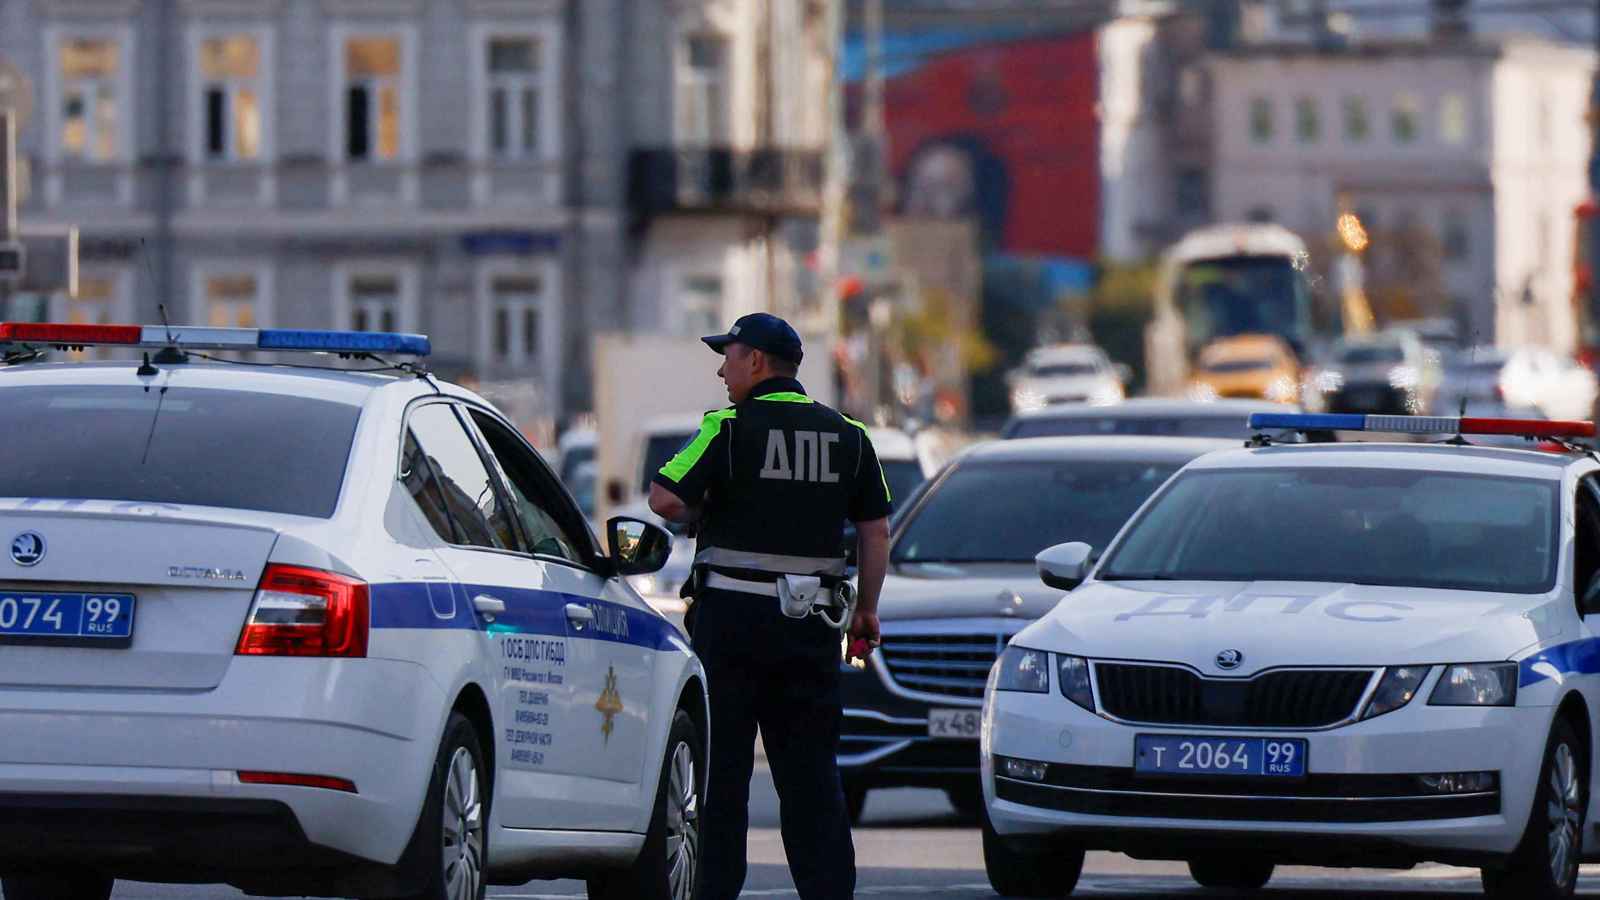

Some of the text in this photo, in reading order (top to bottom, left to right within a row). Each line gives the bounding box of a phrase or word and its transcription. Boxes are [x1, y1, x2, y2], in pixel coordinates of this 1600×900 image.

[759, 428, 840, 483] ДПС
[86, 597, 120, 622] 99
[1113, 592, 1415, 623] ДПС
[88, 622, 113, 633] RUS
[1152, 742, 1296, 770] Т 2064 99
[1269, 764, 1291, 773] RUS
